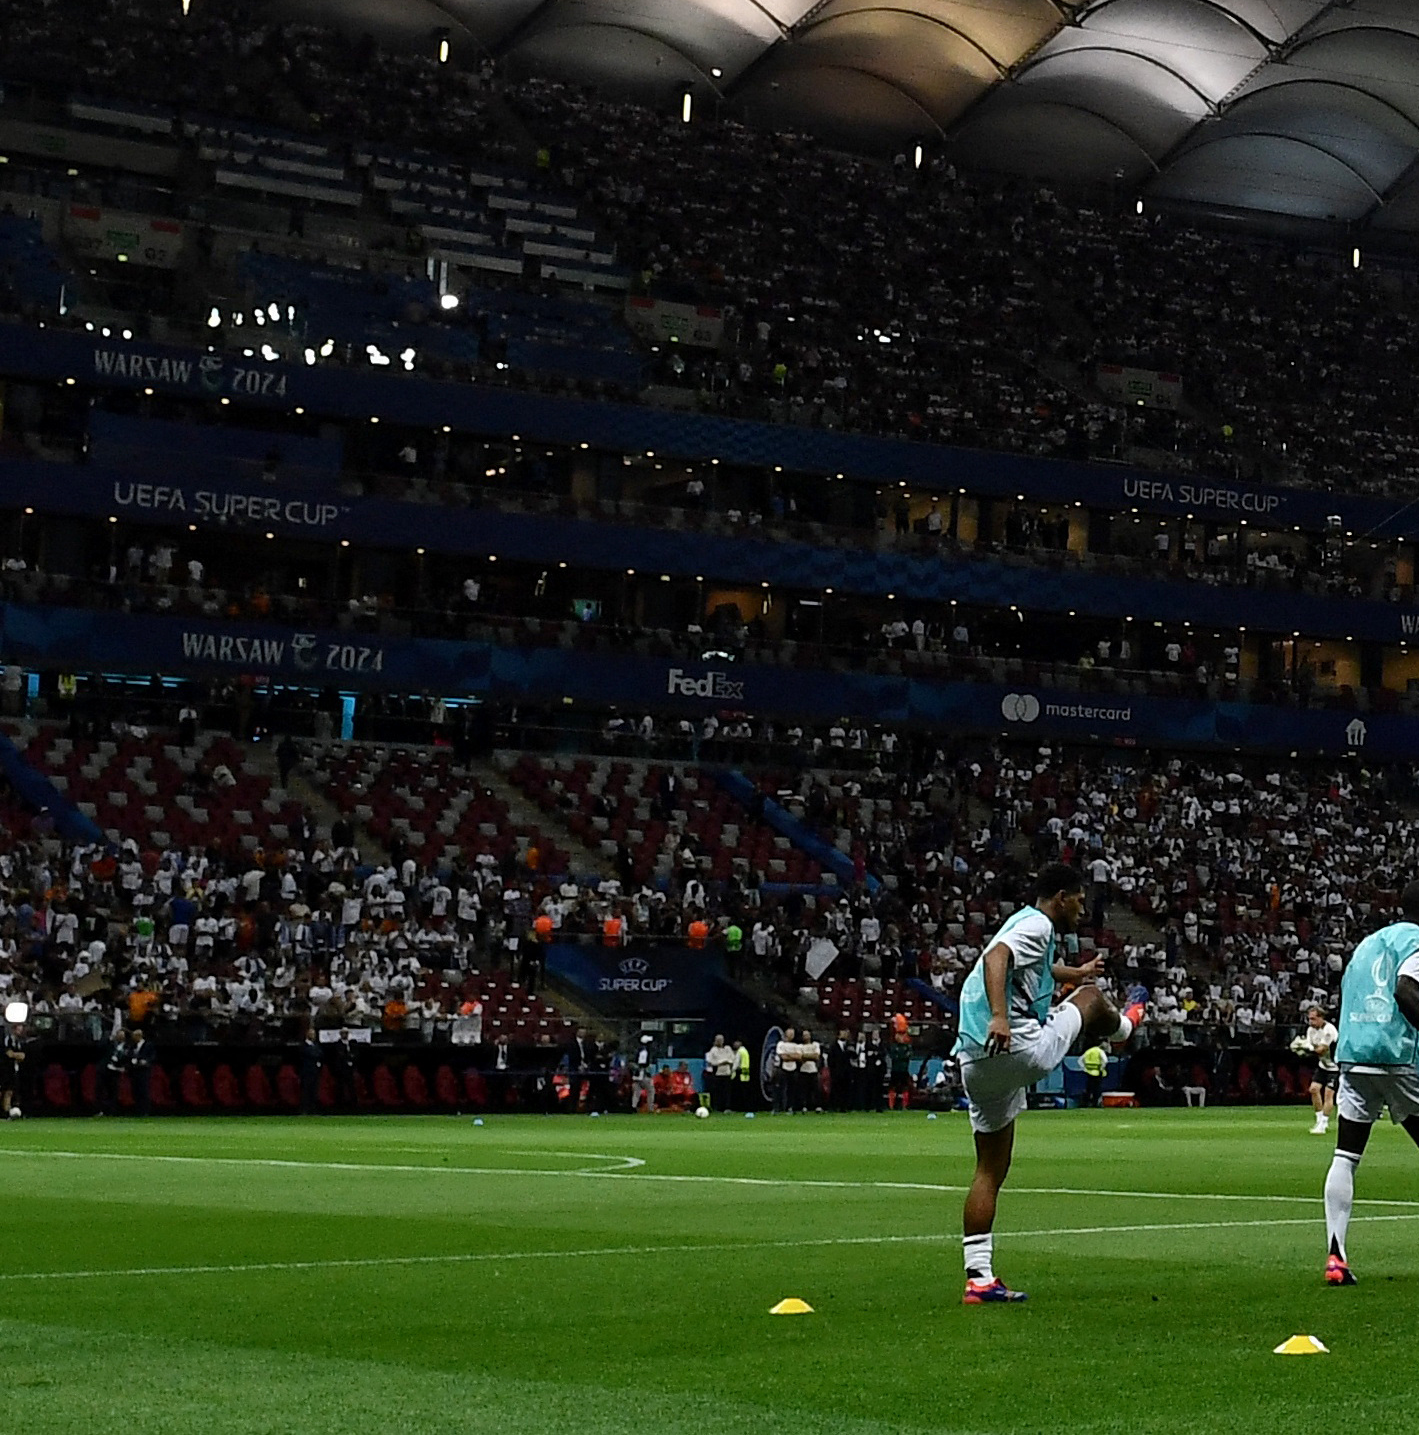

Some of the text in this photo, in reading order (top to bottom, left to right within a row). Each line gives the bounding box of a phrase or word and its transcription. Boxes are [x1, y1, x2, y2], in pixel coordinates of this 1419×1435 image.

[94, 350, 289, 397] WARSAW 2024
[114, 482, 187, 510] UEFA
[194, 491, 281, 521] SUPER
[1124, 479, 1174, 502] UEFA
[1179, 485, 1240, 510] SUPER
[182, 632, 383, 673] WARSAW 2024
[667, 668, 744, 700] FedEx
[1045, 703, 1132, 721] mastercard
[598, 978, 640, 992] SUPER
